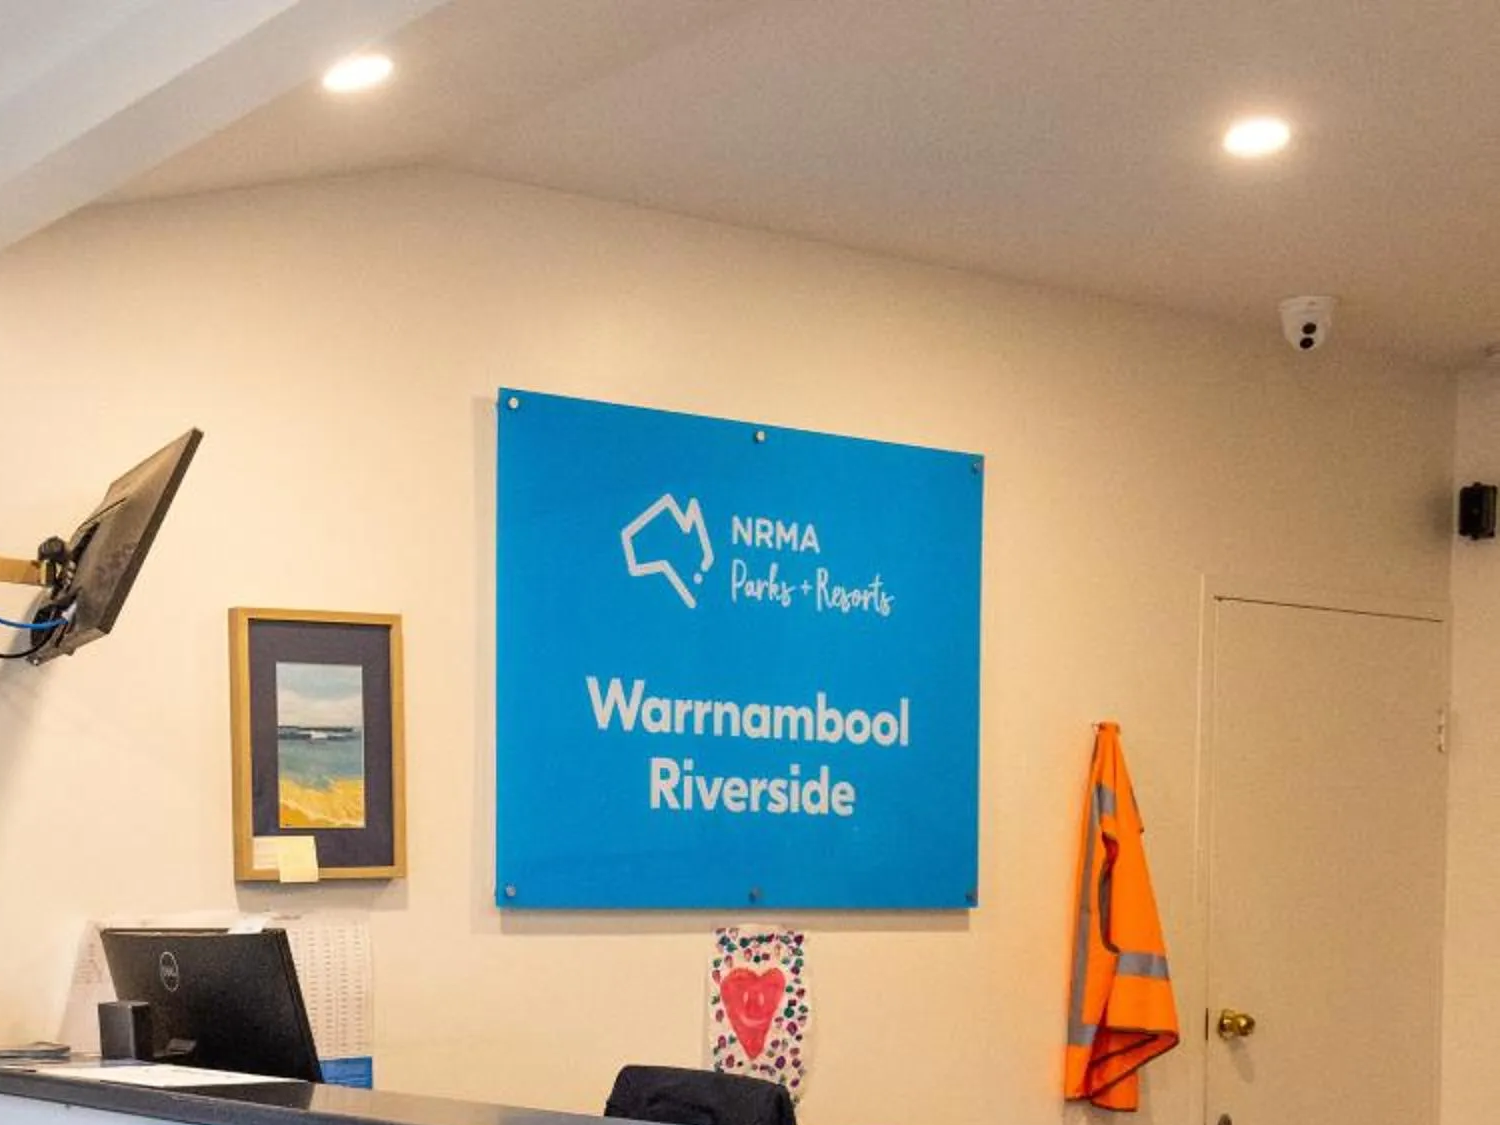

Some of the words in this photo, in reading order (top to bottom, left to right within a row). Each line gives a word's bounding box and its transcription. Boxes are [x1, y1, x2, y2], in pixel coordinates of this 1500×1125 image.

[731, 515, 820, 553] NRMA
[731, 558, 795, 607] Parks
[816, 567, 894, 616] Resorts
[586, 676, 909, 747] Warrnambool
[650, 757, 856, 817] Riverside
